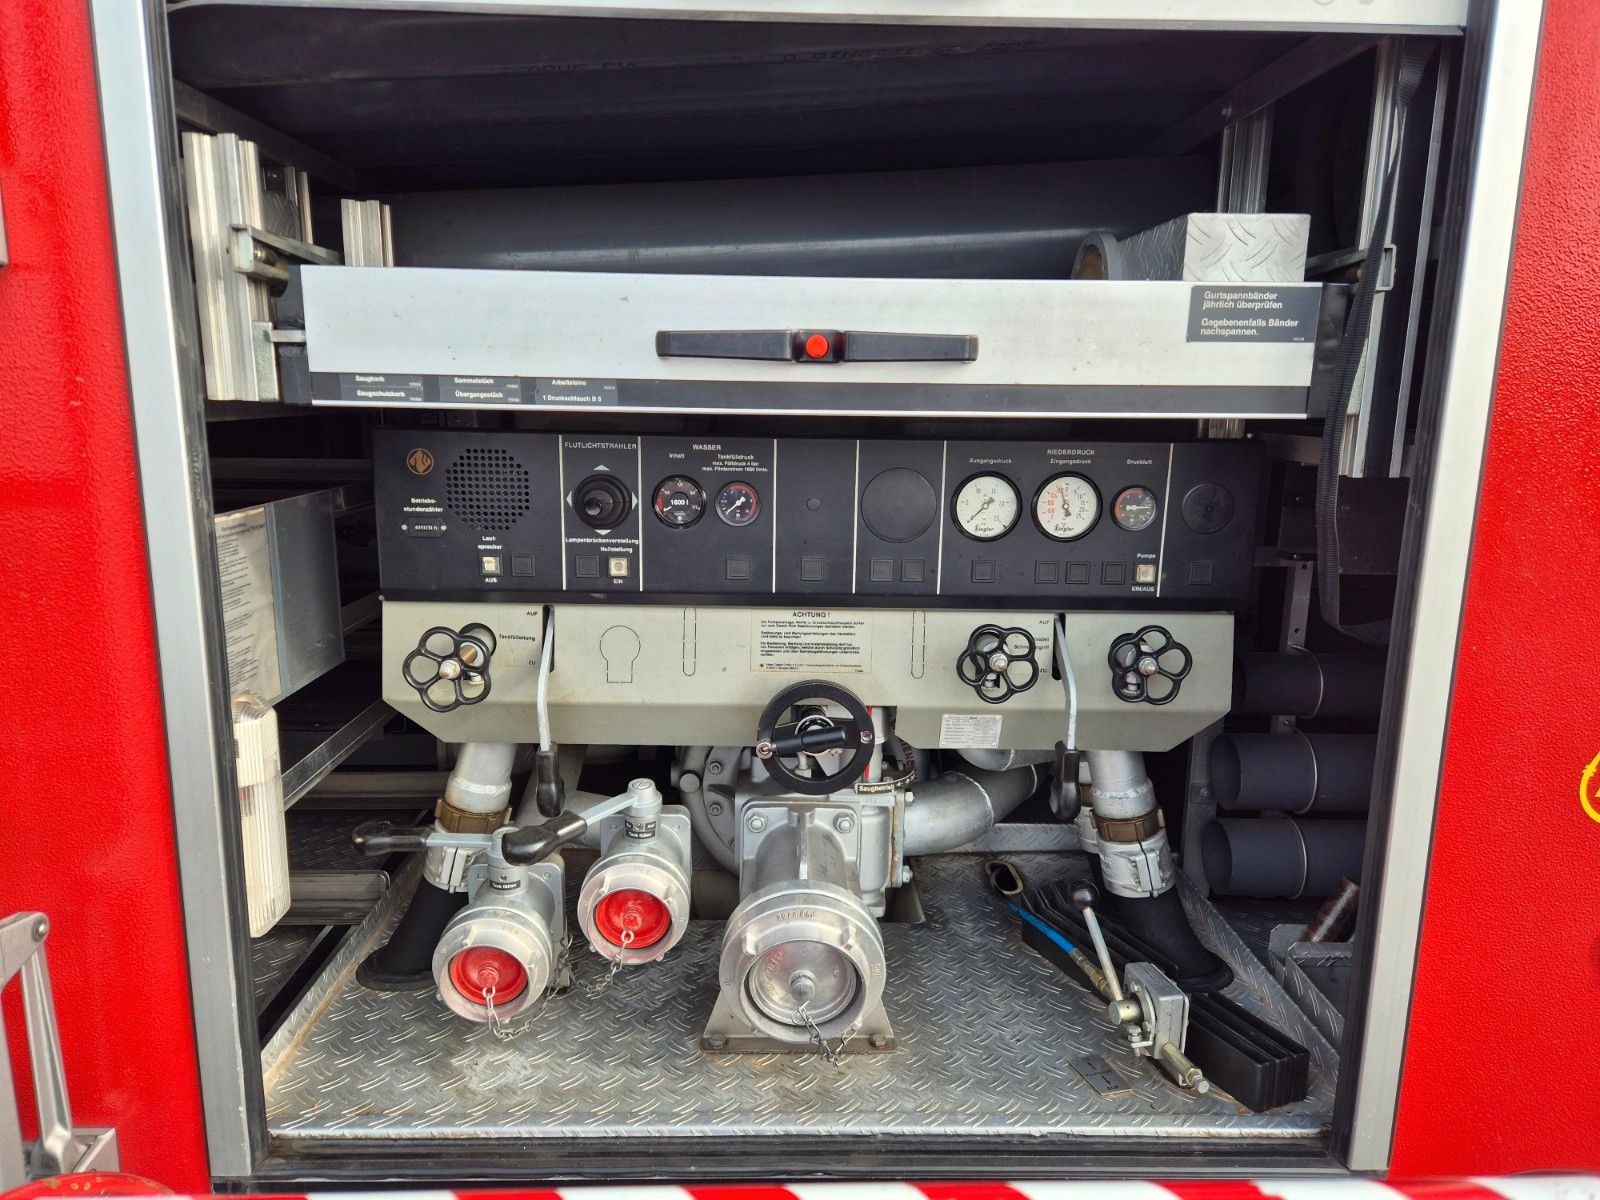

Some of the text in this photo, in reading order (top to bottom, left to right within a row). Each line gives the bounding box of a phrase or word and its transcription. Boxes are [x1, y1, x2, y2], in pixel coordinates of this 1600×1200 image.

[1204, 290, 1278, 300] Gurtspannbänder
[1203, 300, 1283, 310] jährlich überprüfen
[1201, 318, 1299, 328] Gegebenenfalls Bänder
[1200, 328, 1259, 337] nachspannen.
[355, 374, 386, 383] Saugkorb
[356, 389, 406, 398] Saugschutzkorb
[455, 389, 504, 399] Übergangsstück
[547, 394, 591, 402] Druckschlauch
[564, 441, 637, 450] FLUTLICHTSTRAHLER
[858, 784, 895, 793] Saugbetrieb
